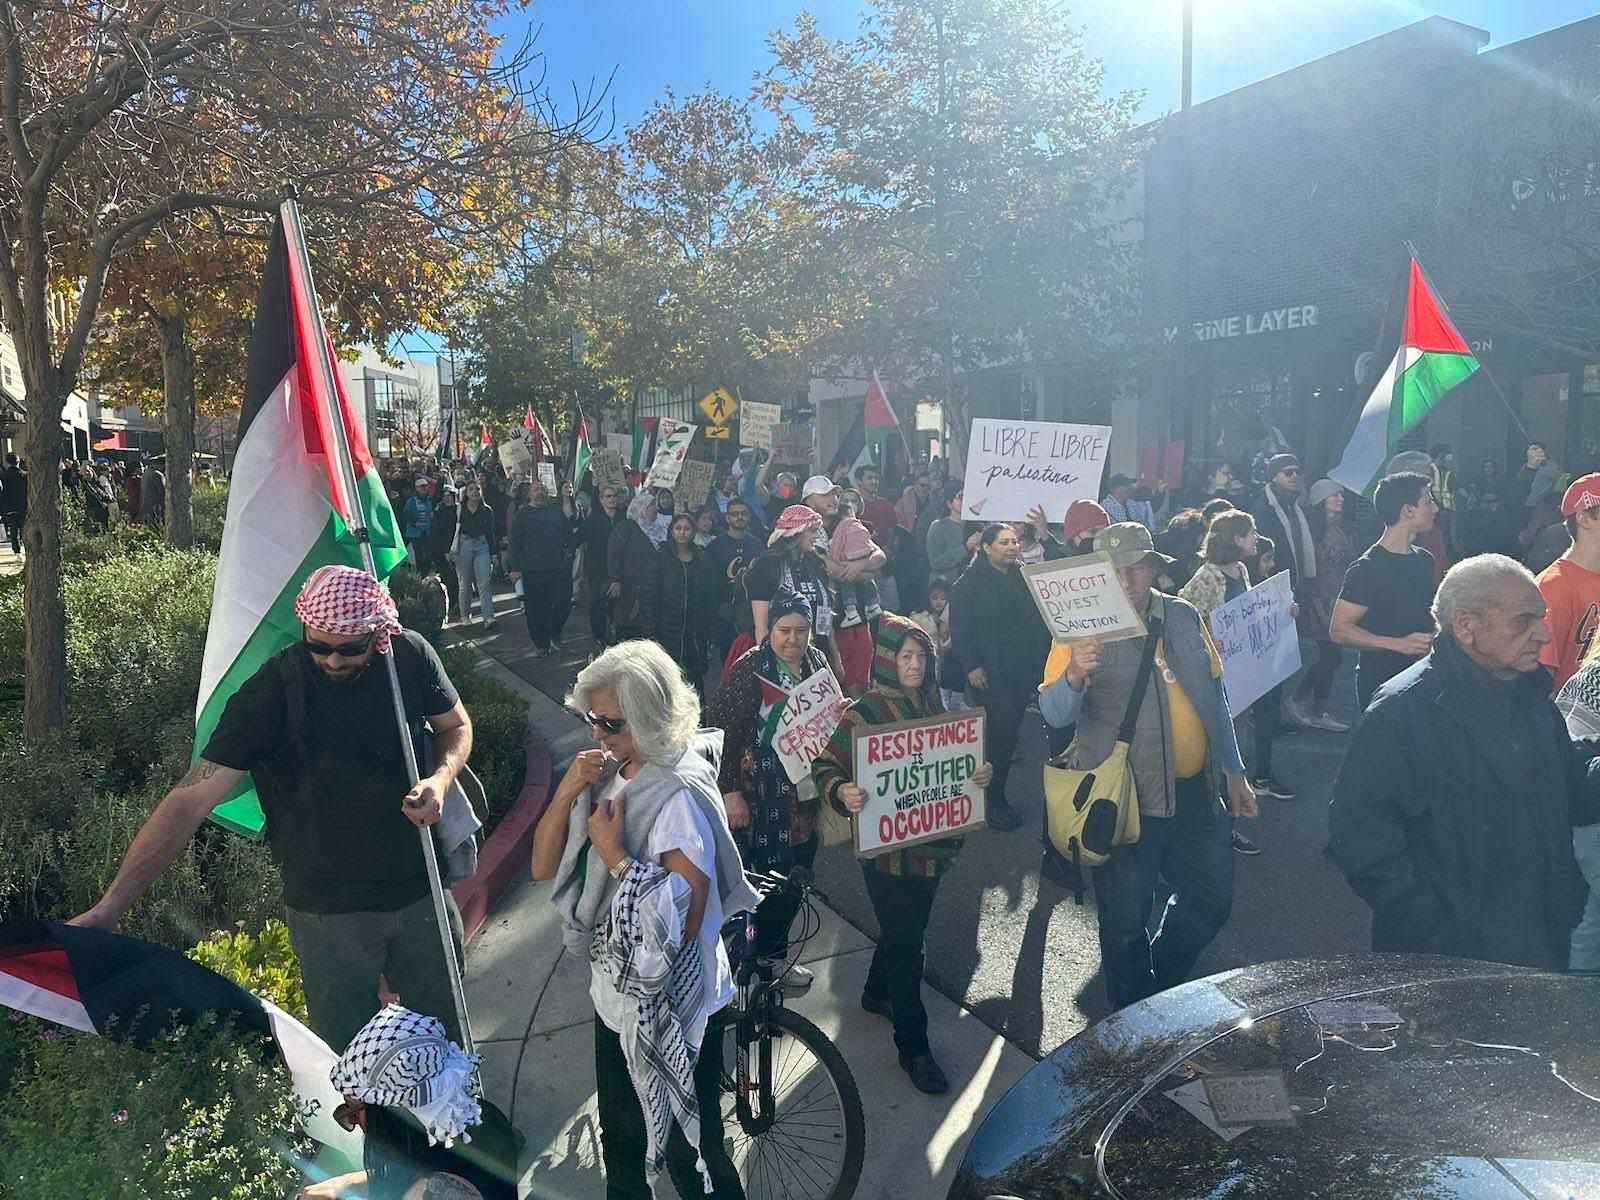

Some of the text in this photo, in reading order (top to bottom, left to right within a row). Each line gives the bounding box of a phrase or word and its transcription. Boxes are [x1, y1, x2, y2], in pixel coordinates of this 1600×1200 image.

[1163, 305, 1319, 344] MRINE LAYER
[983, 425, 1103, 462] LIBRE LIBRE
[981, 464, 1079, 488] palestina
[1036, 574, 1107, 600] BOYCOTT
[1045, 595, 1100, 617] DIVEST
[1054, 616, 1120, 633] SANCTION
[810, 677, 836, 703] SAY
[867, 719, 978, 765] RESISTANCE
[911, 752, 923, 765] IS
[876, 753, 976, 797] JUSTIFIED
[894, 784, 964, 811] WHEN PEOPLE ARE
[879, 794, 972, 843] OCCUPIED
